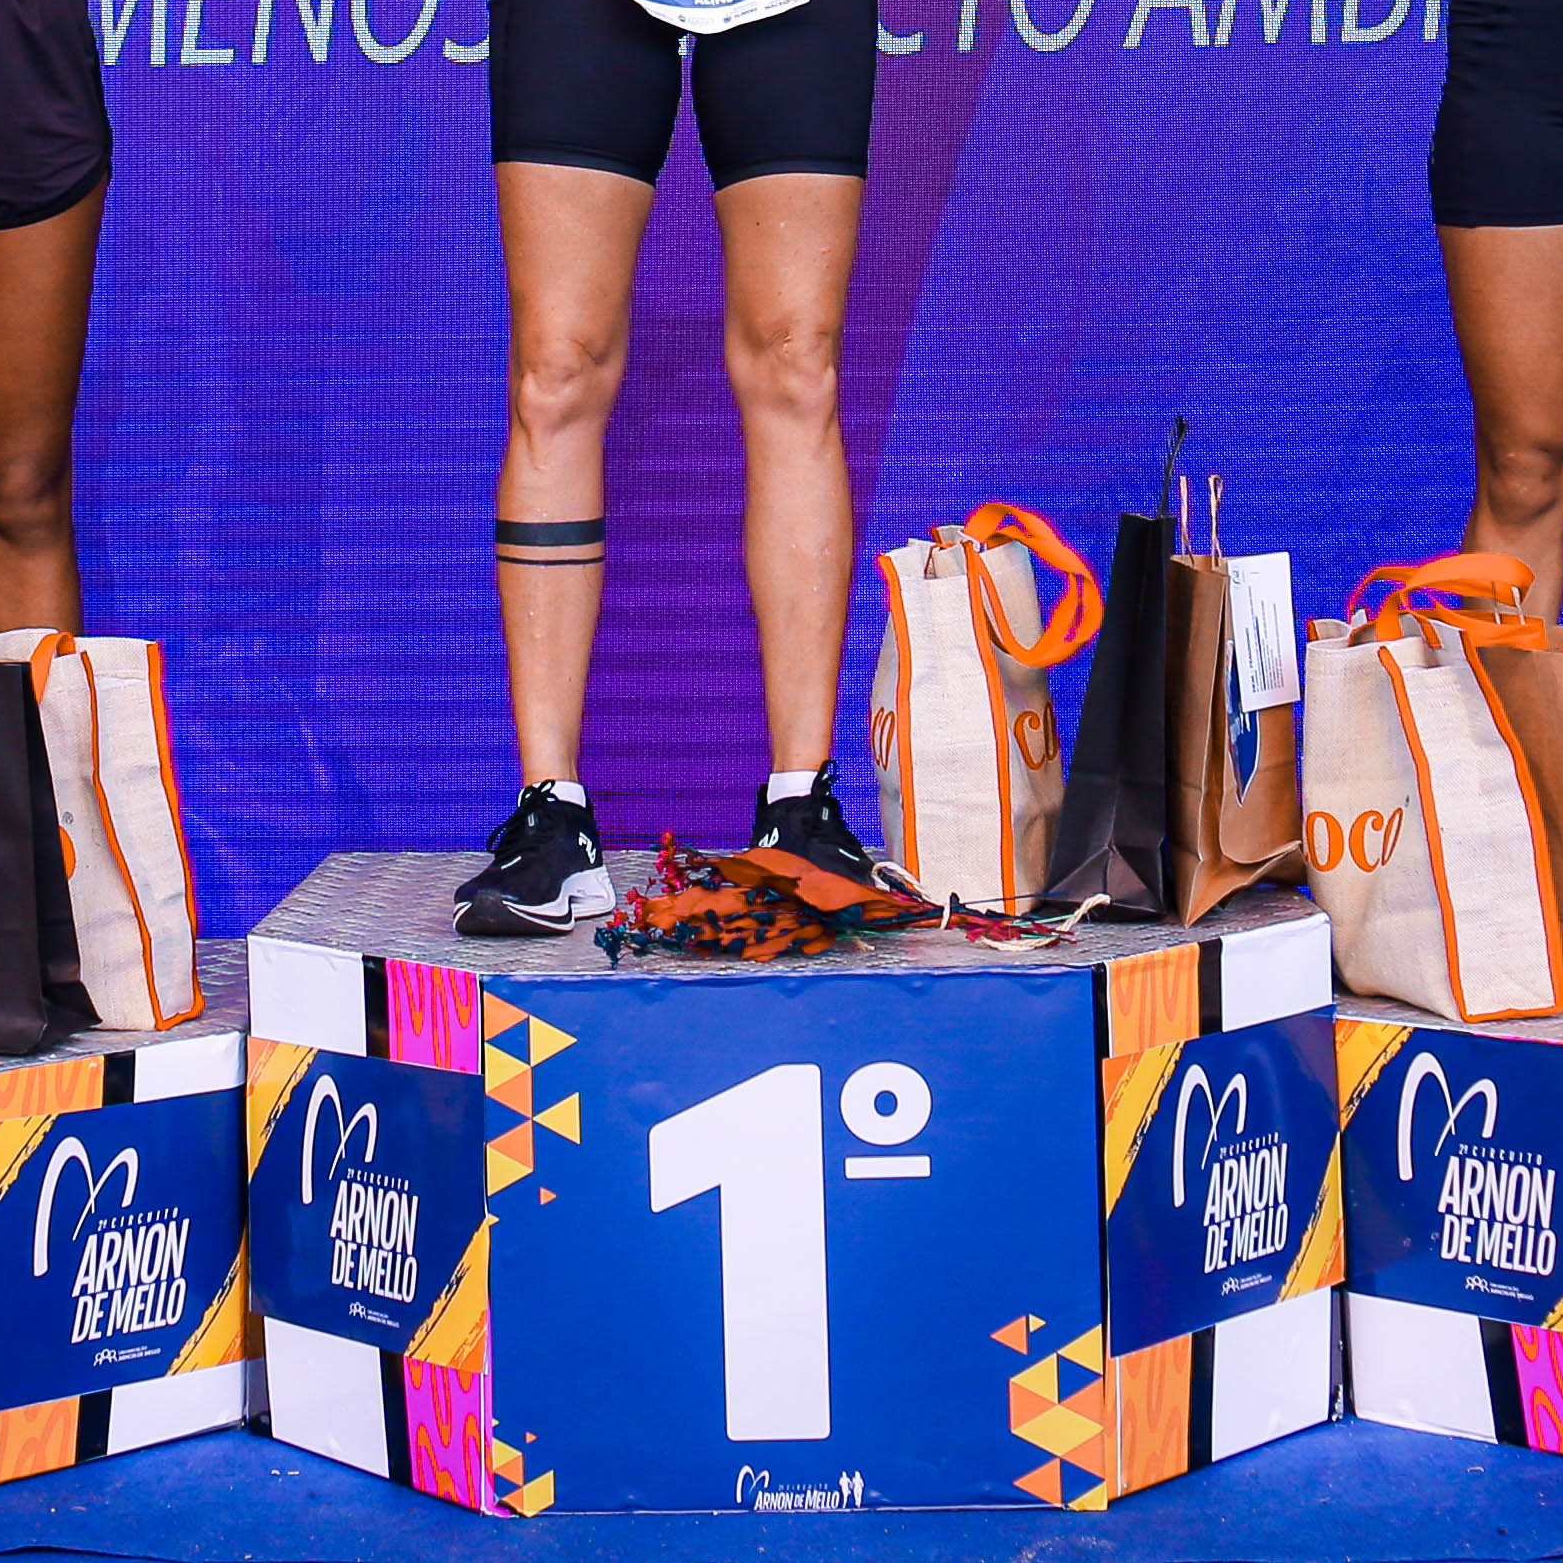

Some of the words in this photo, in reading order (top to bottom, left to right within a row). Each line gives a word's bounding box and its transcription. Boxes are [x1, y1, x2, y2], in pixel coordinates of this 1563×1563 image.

[1229, 1131, 1279, 1157] CIRCUITO
[1472, 1144, 1543, 1166] CIRCUITO
[111, 1206, 179, 1229] CIRCUITO
[329, 1179, 419, 1256] ARNON
[1203, 1143, 1288, 1227] ARNON
[1437, 1155, 1556, 1229] ARNON
[71, 1217, 190, 1298] ARNON
[331, 1238, 357, 1289] DE
[356, 1245, 418, 1304] MELLO
[648, 1060, 933, 1442] 1º
[1204, 1220, 1231, 1274] DE
[1230, 1203, 1289, 1267] MELLO
[1440, 1213, 1475, 1264] DE
[1475, 1219, 1557, 1277] MELLO
[70, 1292, 109, 1344] DE
[106, 1277, 186, 1338] MELLO
[754, 1490, 794, 1511] ARNON
[793, 1493, 804, 1508] DE
[804, 1489, 840, 1510] MELLO
